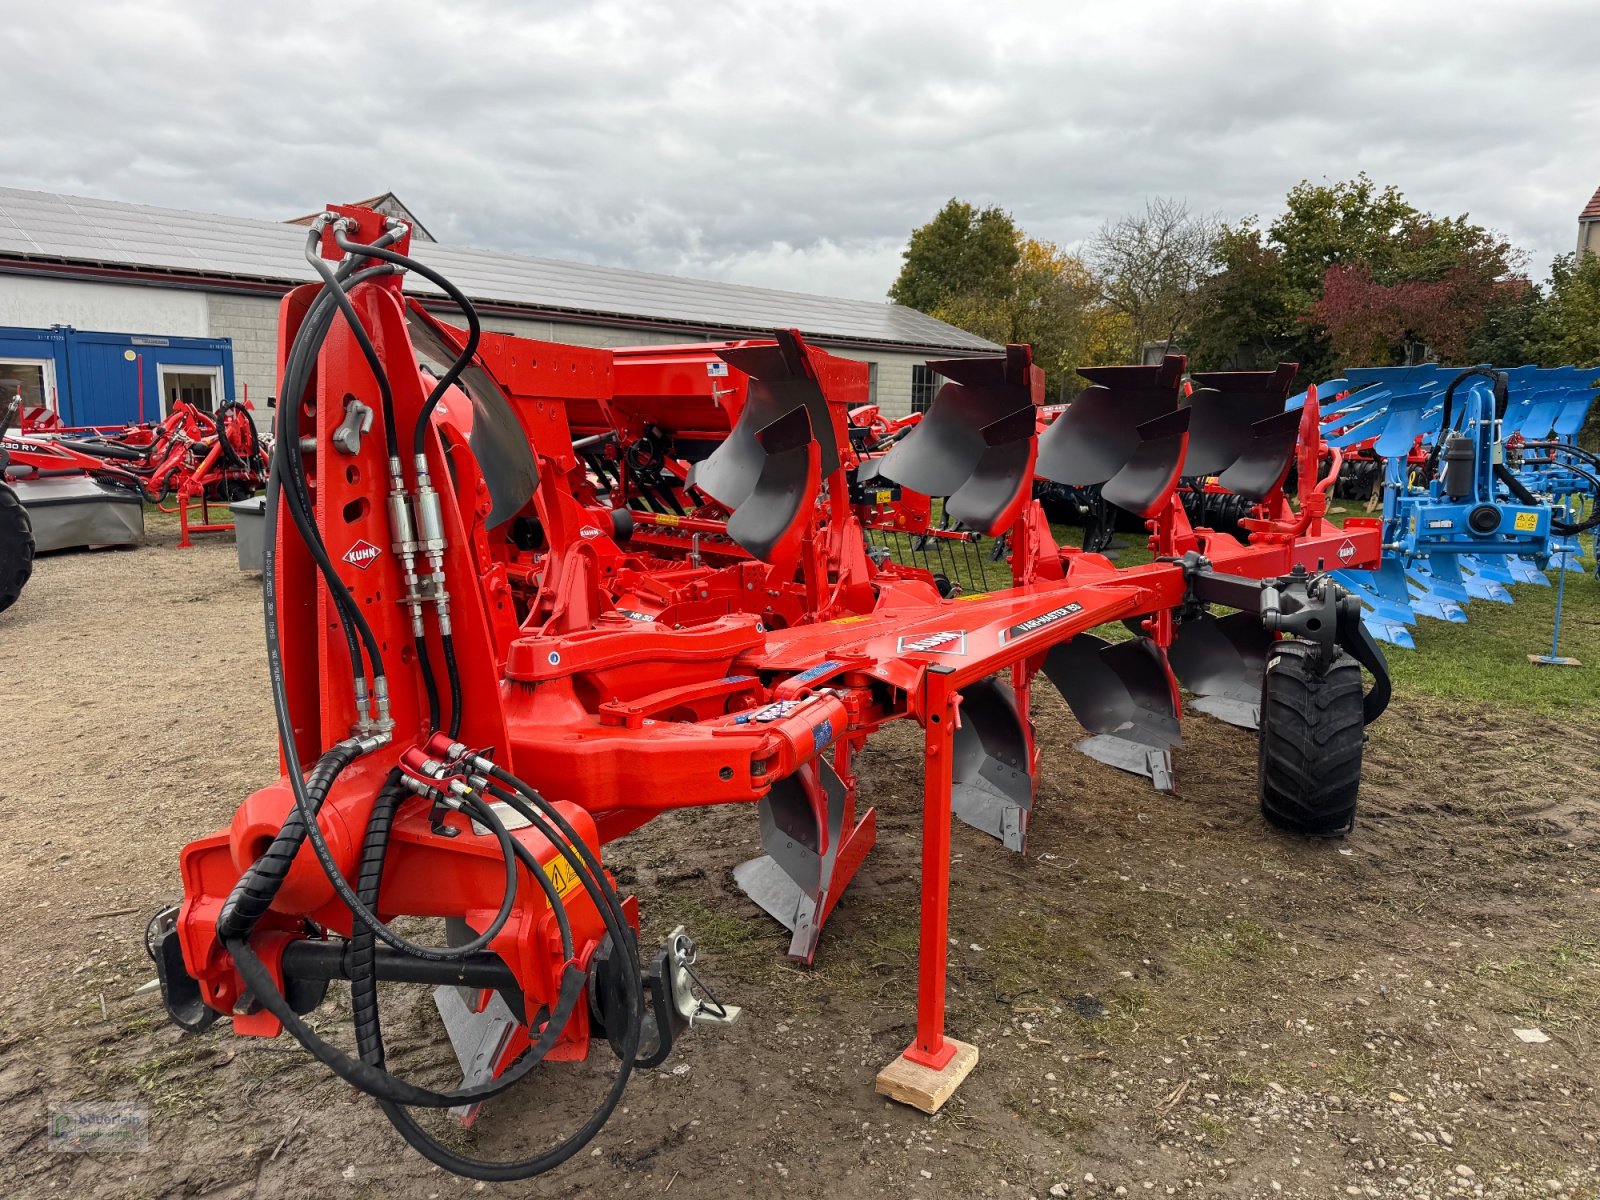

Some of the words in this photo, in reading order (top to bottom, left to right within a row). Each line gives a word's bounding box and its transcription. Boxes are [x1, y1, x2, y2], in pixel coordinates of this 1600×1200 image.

[349, 547, 375, 562] KUHN
[1339, 547, 1354, 562] KUHN
[630, 611, 643, 620] HR
[902, 631, 964, 651] KUHN
